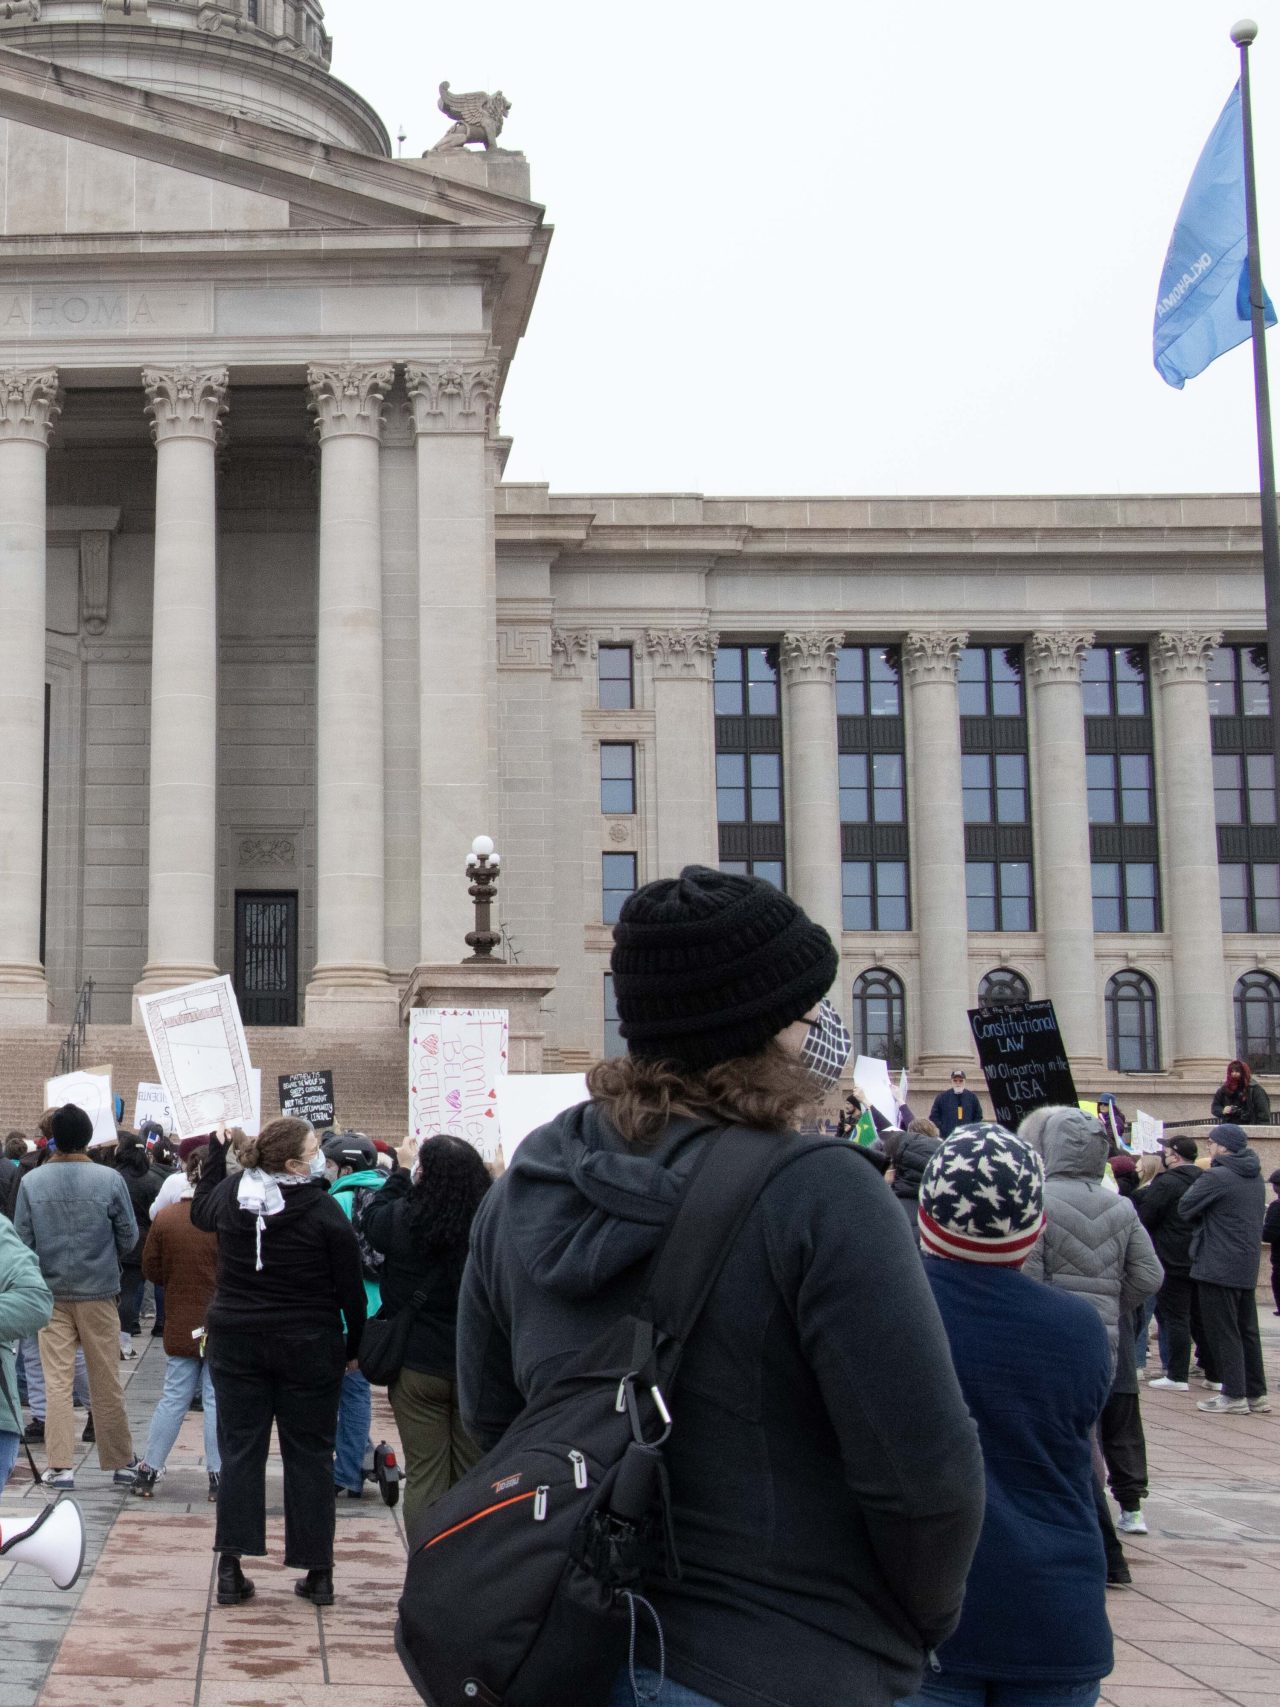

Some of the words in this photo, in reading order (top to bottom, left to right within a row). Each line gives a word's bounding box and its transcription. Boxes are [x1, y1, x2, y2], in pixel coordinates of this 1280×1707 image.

[973, 1009, 1057, 1039] Constitutional
[997, 1035, 1024, 1053] LAW
[984, 1064, 997, 1079] NO
[998, 1060, 1046, 1081] Oligarchy
